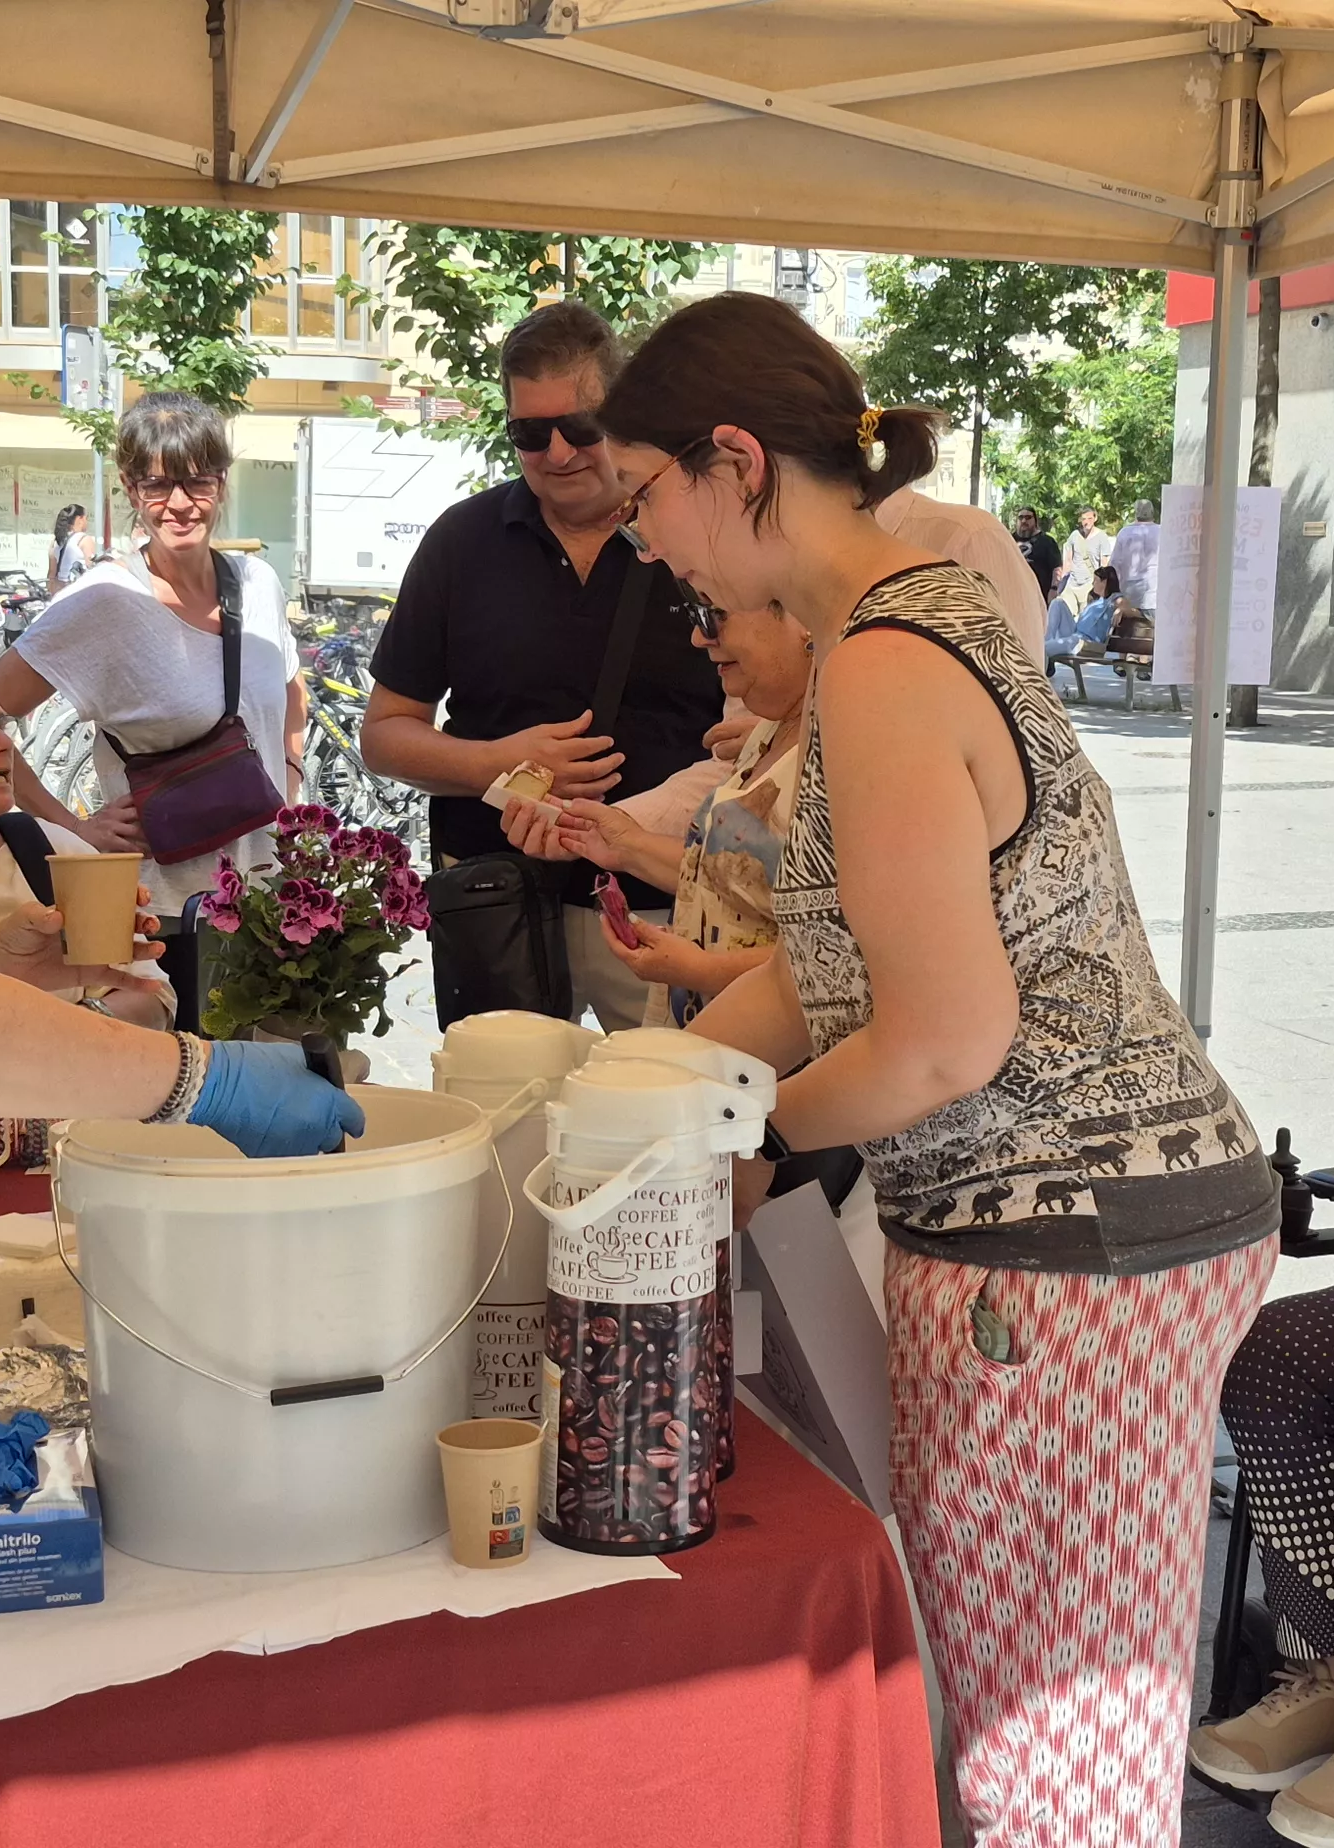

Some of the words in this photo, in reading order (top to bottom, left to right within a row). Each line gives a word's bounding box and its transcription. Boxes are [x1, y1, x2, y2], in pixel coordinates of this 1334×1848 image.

[659, 1184, 699, 1207] CAFÉ
[617, 1208, 679, 1224] COFFEE
[645, 1223, 694, 1249] CAFÉ
[562, 1280, 615, 1300] COFFEE
[633, 1285, 667, 1297] coffee
[477, 1310, 512, 1323] offee
[476, 1332, 535, 1345] COFFEE
[502, 1351, 543, 1368] CAF
[492, 1402, 527, 1413] coffee
